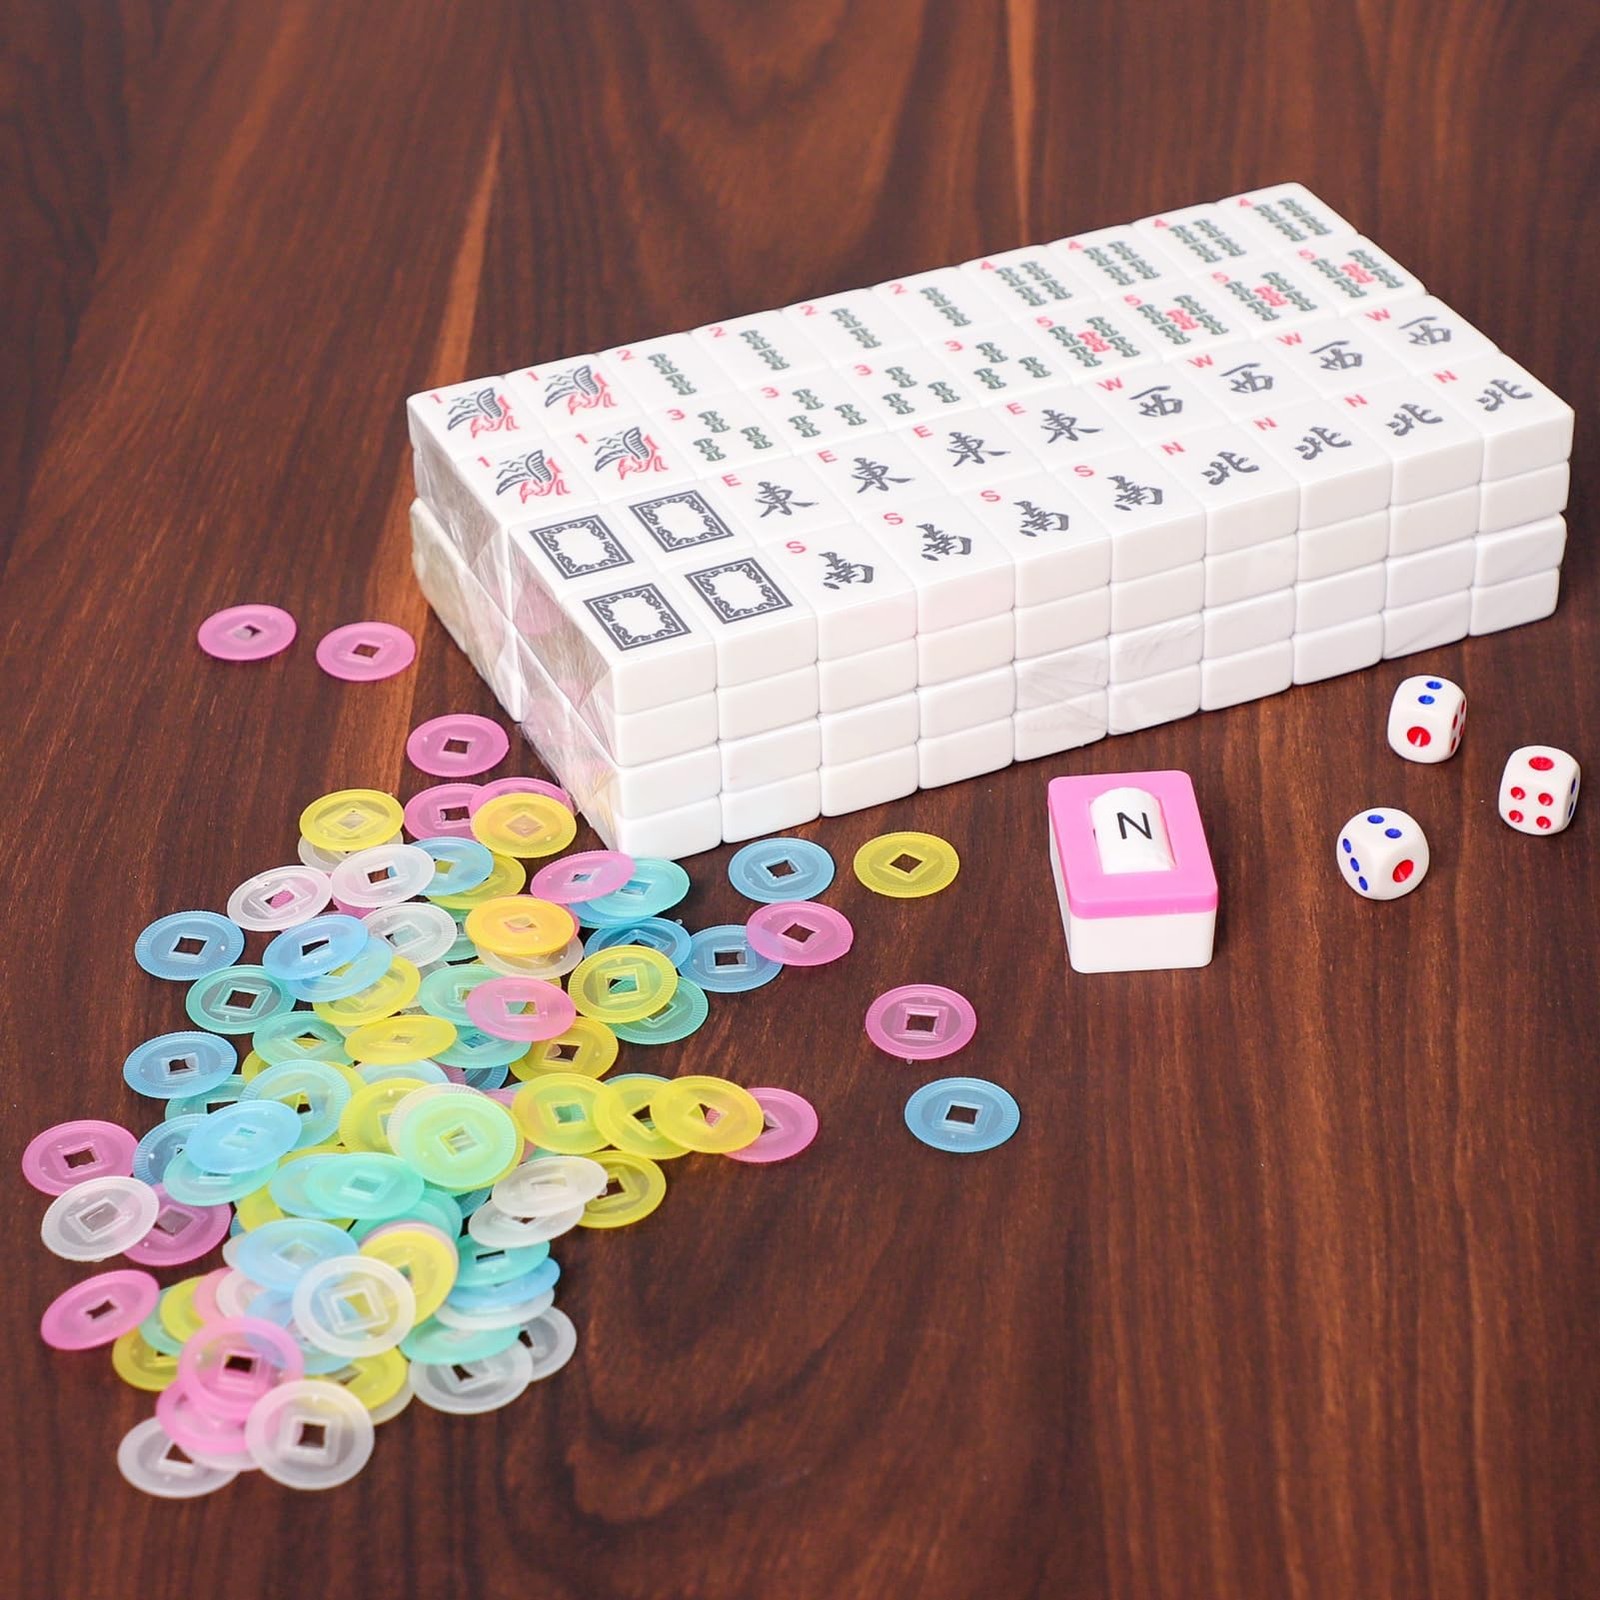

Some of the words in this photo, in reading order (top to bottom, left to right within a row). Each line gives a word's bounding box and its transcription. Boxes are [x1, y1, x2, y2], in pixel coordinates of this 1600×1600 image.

[1238, 197, 1253, 208] 4
[1152, 217, 1169, 230] 4
[1067, 239, 1084, 252] 4
[1296, 247, 1317, 262] 5
[980, 260, 996, 271] 4
[1211, 271, 1230, 285] 5
[889, 281, 908, 296] 2
[1122, 293, 1143, 309] 5
[799, 303, 816, 317] 2
[1365, 308, 1391, 322] W
[1034, 315, 1054, 329] 5
[707, 325, 726, 339] 2
[1400, 317, 1451, 345] 西
[944, 339, 965, 353] 3
[1277, 331, 1304, 347] W
[617, 347, 634, 361] 2
[1311, 341, 1363, 371] 西
[1188, 355, 1215, 369] W
[526, 369, 540, 383] 1
[853, 363, 874, 377] 3
[1434, 369, 1457, 385] N
[1095, 376, 1125, 392] W
[1221, 364, 1273, 394] 西
[430, 392, 444, 405] 1
[761, 385, 781, 400] 3
[1477, 379, 1534, 412] 北
[1130, 387, 1183, 418] 西
[1343, 393, 1368, 408] N
[667, 407, 687, 422] 3
[1005, 401, 1025, 417] E
[1041, 410, 1103, 444] 東
[1254, 416, 1278, 432] N
[1387, 404, 1444, 437] 北
[575, 432, 589, 445] 1
[912, 424, 933, 439] E
[947, 432, 1010, 468] 東
[1160, 441, 1185, 456] N
[1295, 427, 1352, 461] 北
[478, 455, 492, 468] 1
[816, 449, 837, 464] E
[852, 458, 915, 494] 東
[1071, 464, 1097, 479] S
[1202, 452, 1260, 486] 北
[721, 474, 742, 488] E
[755, 482, 818, 518] 東
[978, 488, 1003, 503] S
[1108, 476, 1163, 512] 南
[881, 511, 905, 527] S
[1014, 501, 1069, 538] 南
[784, 540, 808, 555] S
[917, 524, 972, 562] 南
[819, 552, 874, 590] 南
[1117, 812, 1153, 840] N
